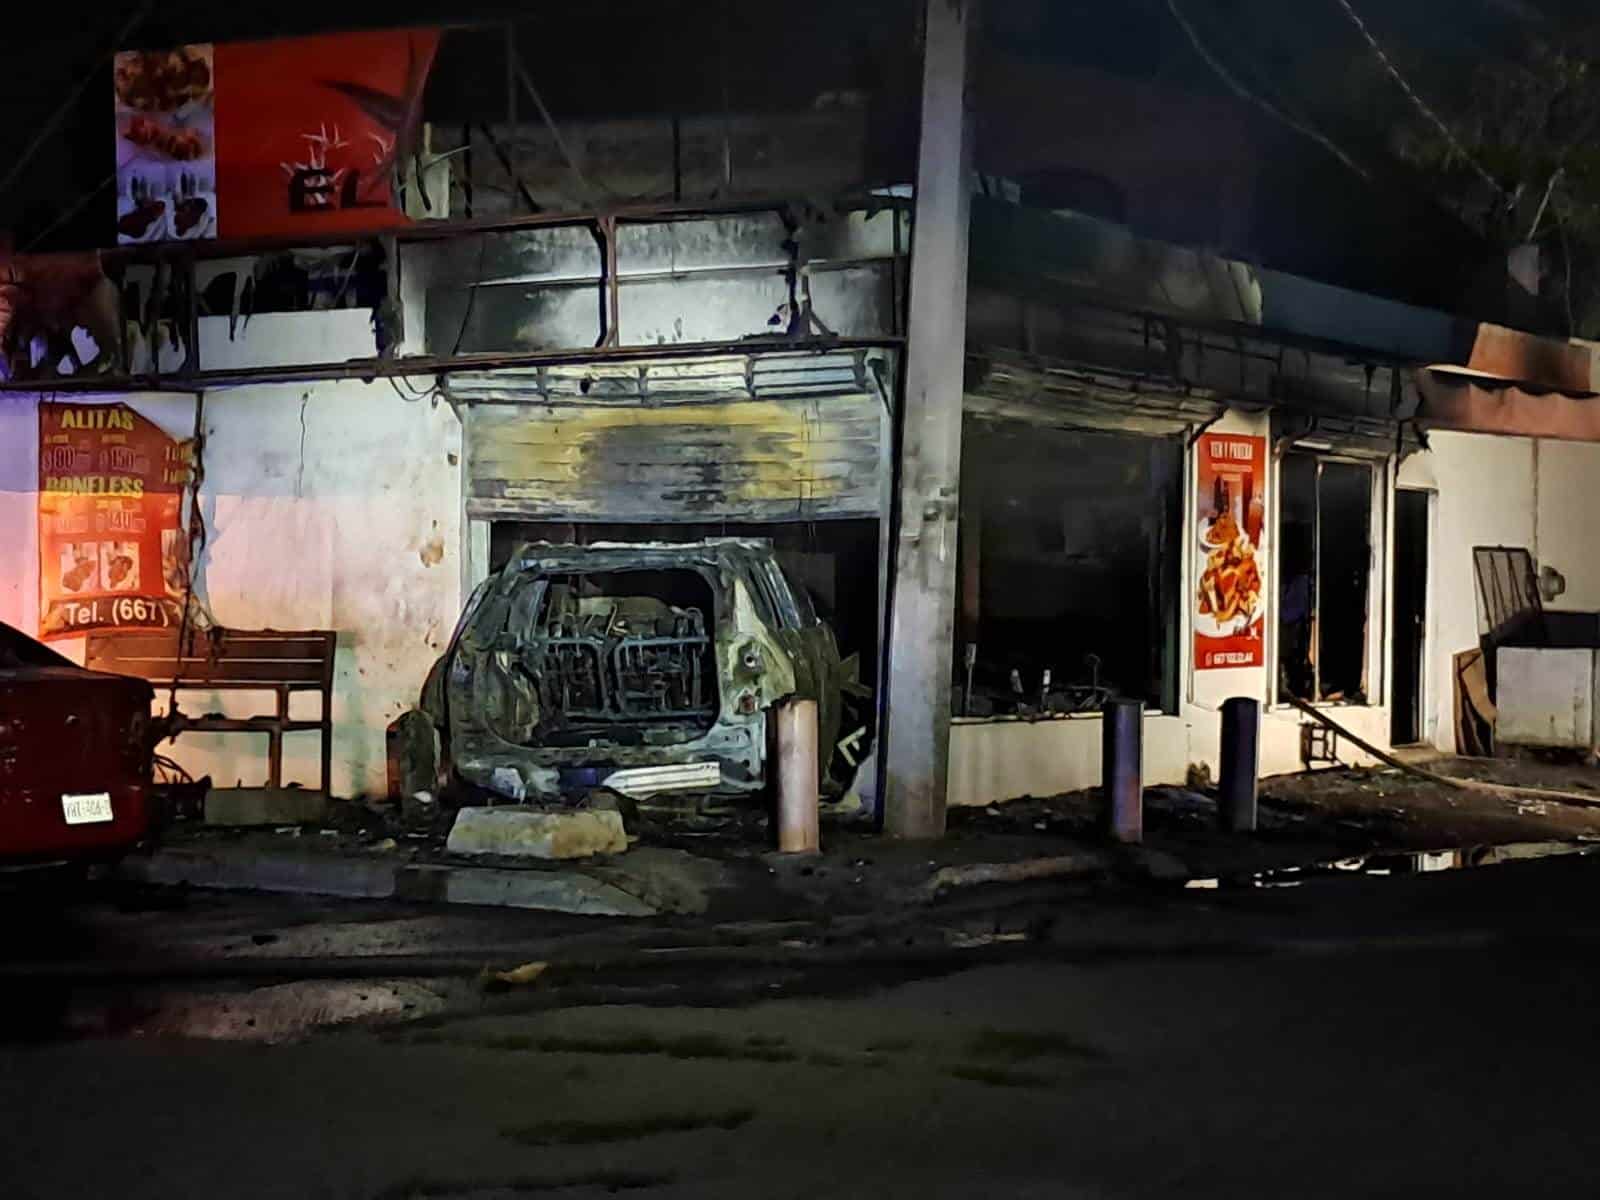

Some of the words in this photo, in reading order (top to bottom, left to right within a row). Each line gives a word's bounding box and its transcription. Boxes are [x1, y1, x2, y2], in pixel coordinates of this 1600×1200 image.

[60, 408, 135, 431] ALITAS
[45, 474, 144, 499] BONELESS
[64, 601, 105, 625] Tel.
[112, 599, 169, 628] (667)
